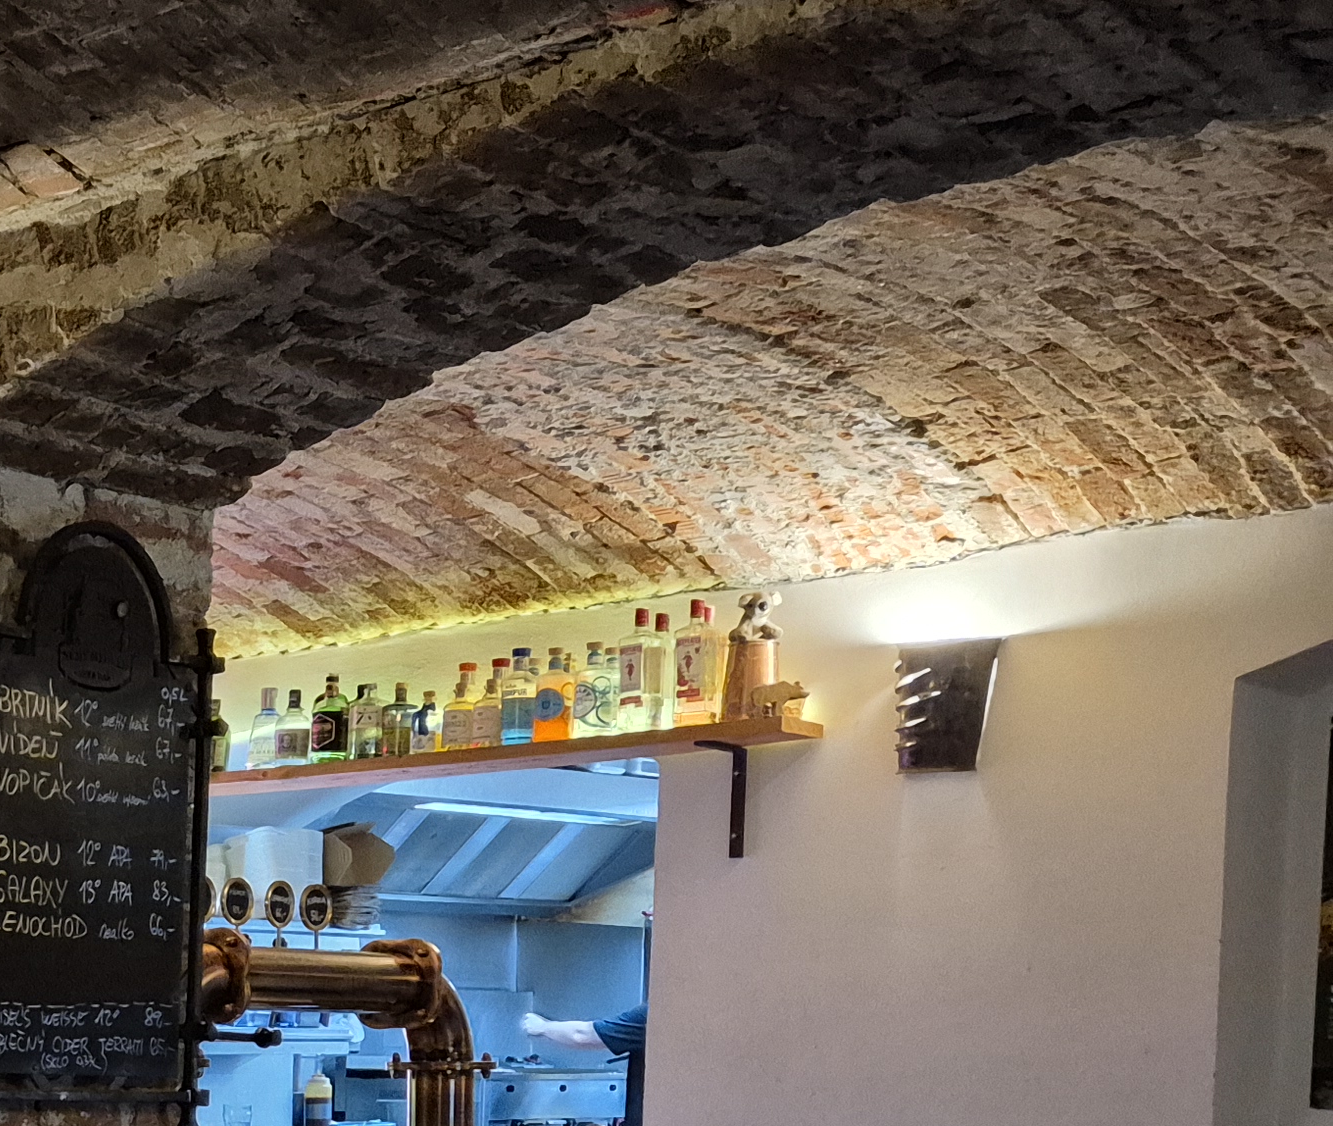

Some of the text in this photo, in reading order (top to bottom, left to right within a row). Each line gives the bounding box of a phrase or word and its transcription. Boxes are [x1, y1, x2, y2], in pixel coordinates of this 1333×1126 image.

[107, 844, 134, 869] APA
[107, 879, 134, 907] APA
[152, 879, 182, 908] 83,-
